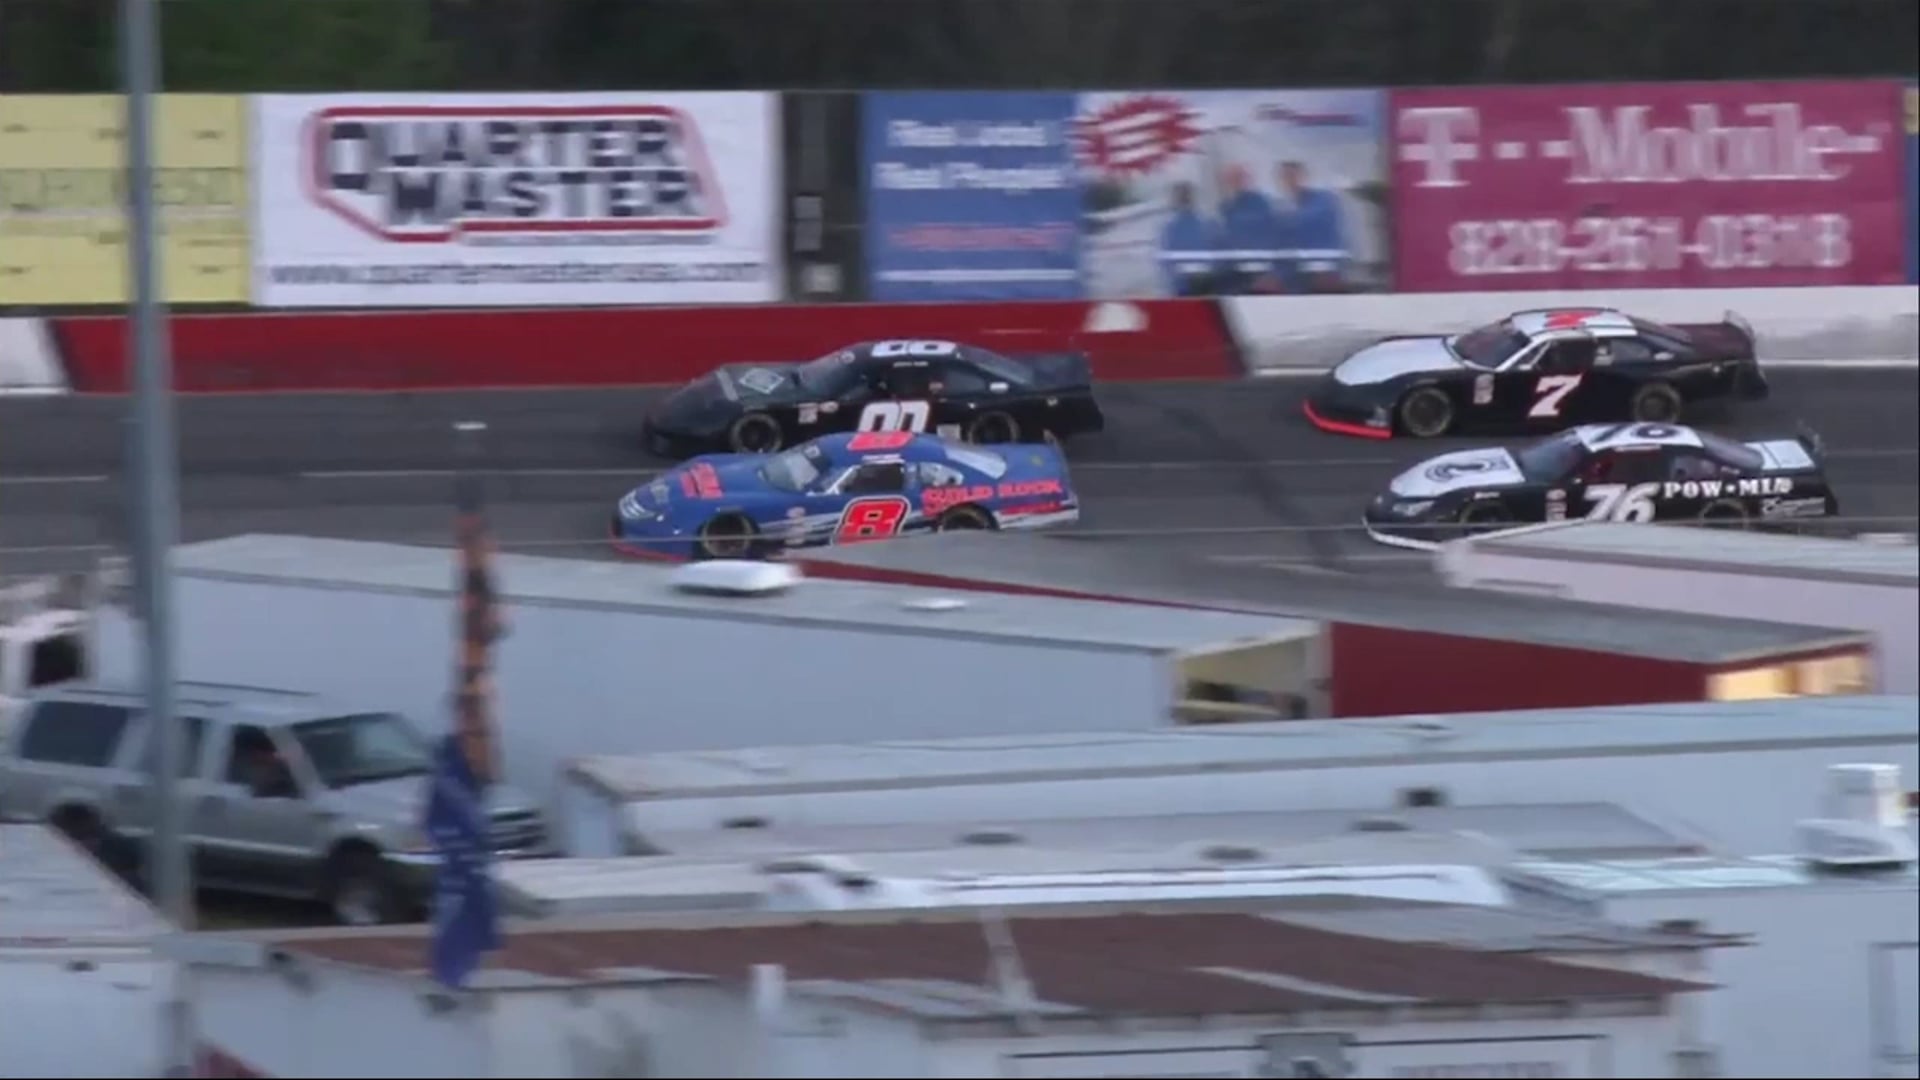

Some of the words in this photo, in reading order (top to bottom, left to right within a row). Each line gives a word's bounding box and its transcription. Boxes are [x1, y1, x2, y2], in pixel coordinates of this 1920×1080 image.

[329, 121, 678, 190] QUARTER
[389, 170, 706, 223] MASTER
[1449, 214, 1851, 274] 828-261-0318
[1527, 372, 1584, 418] 7
[834, 497, 910, 545] 8
[1584, 483, 1660, 522] 76
